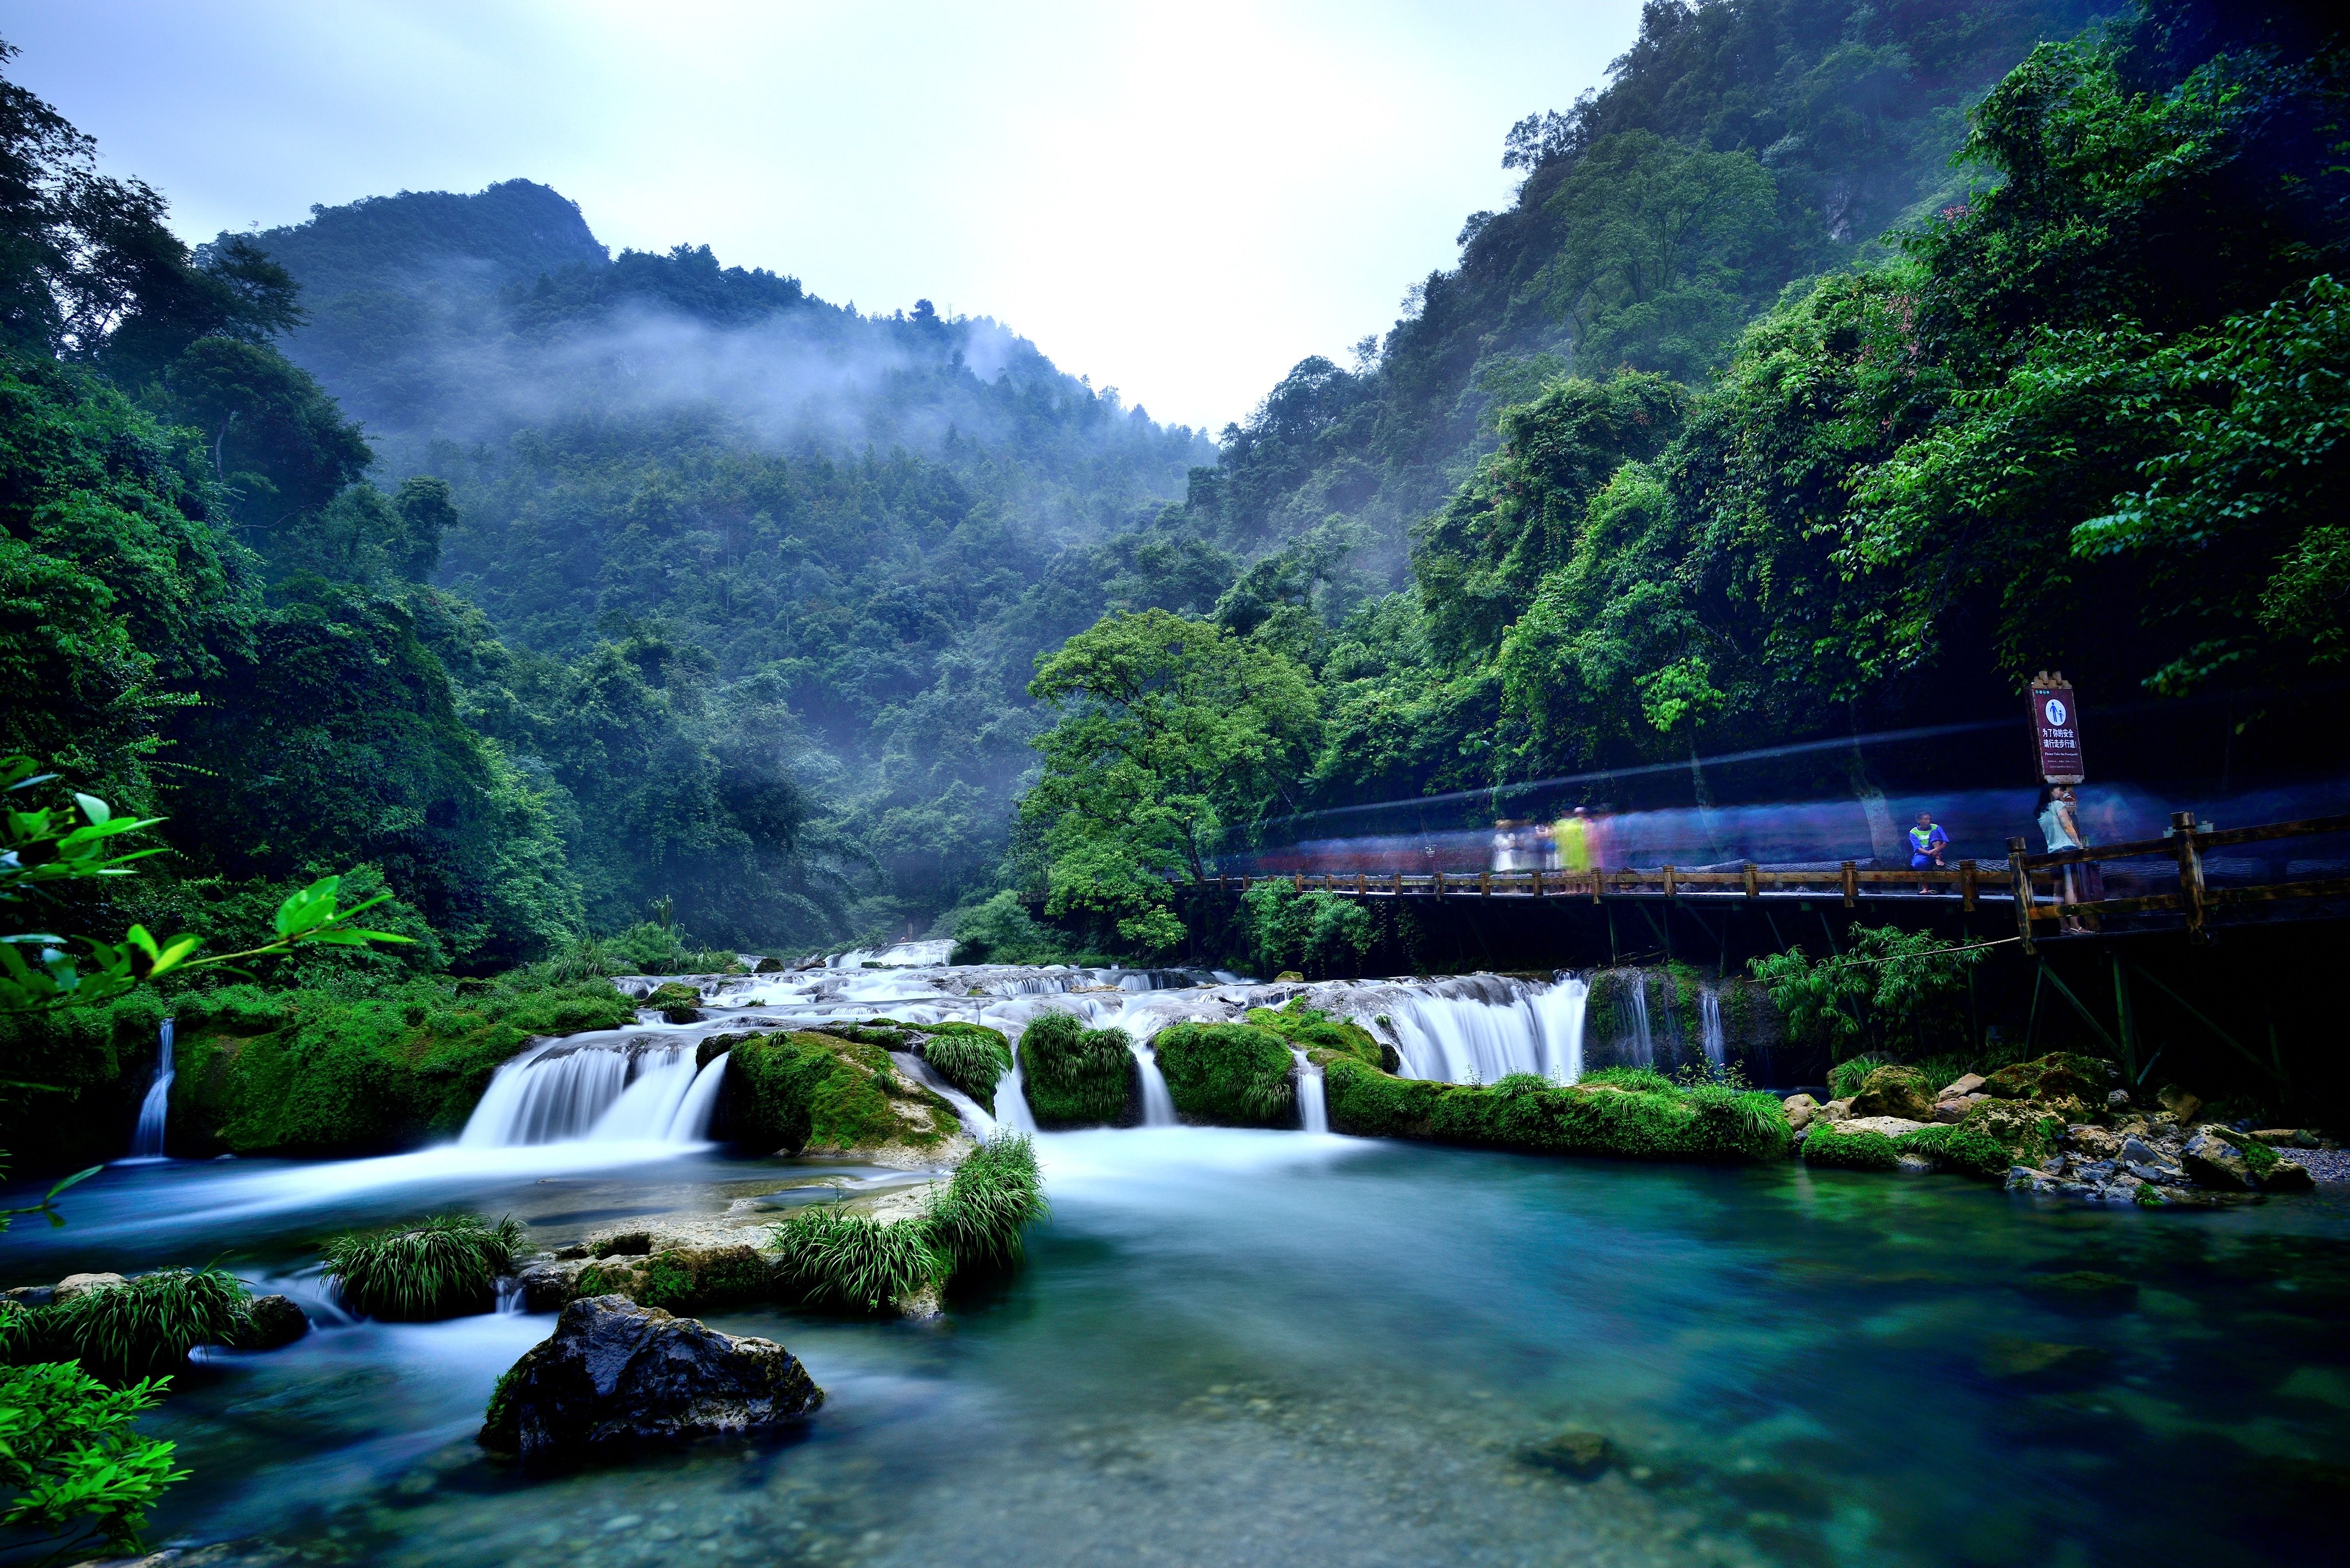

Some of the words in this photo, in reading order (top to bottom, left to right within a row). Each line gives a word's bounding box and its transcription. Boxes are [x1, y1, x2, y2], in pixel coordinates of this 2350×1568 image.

[2043, 728, 2074, 737] 为了你的安全
